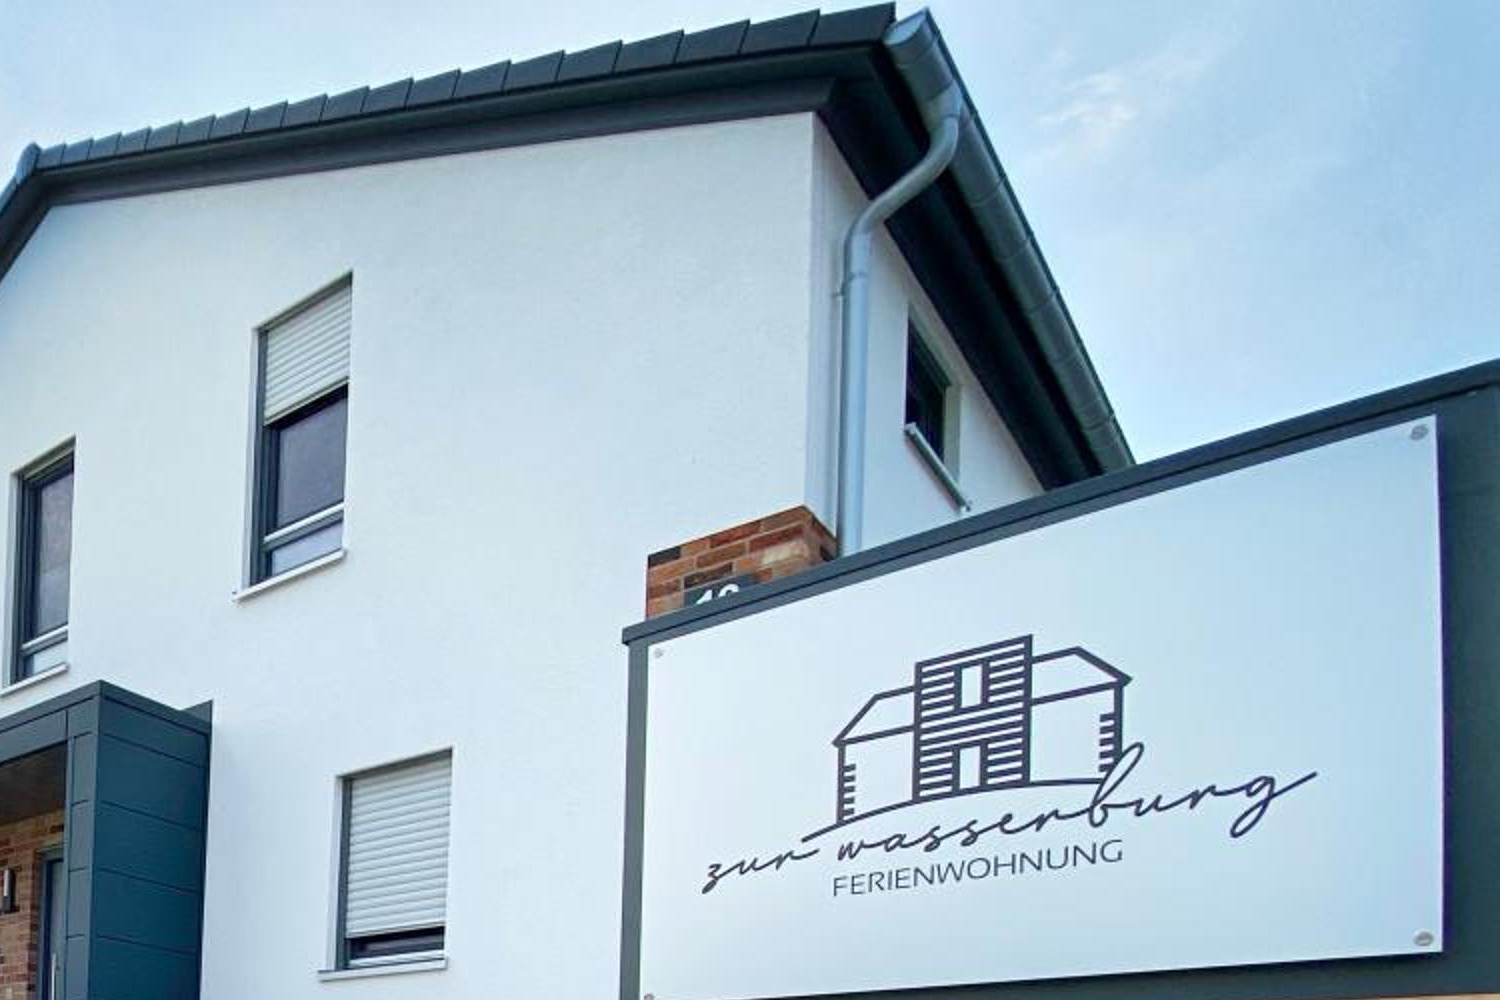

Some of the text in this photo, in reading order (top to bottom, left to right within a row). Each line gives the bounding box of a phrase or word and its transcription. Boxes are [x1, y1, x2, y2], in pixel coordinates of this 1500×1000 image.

[702, 742, 1317, 893] zur wasserburg
[833, 838, 1123, 896] FERIENWOHNUNG
